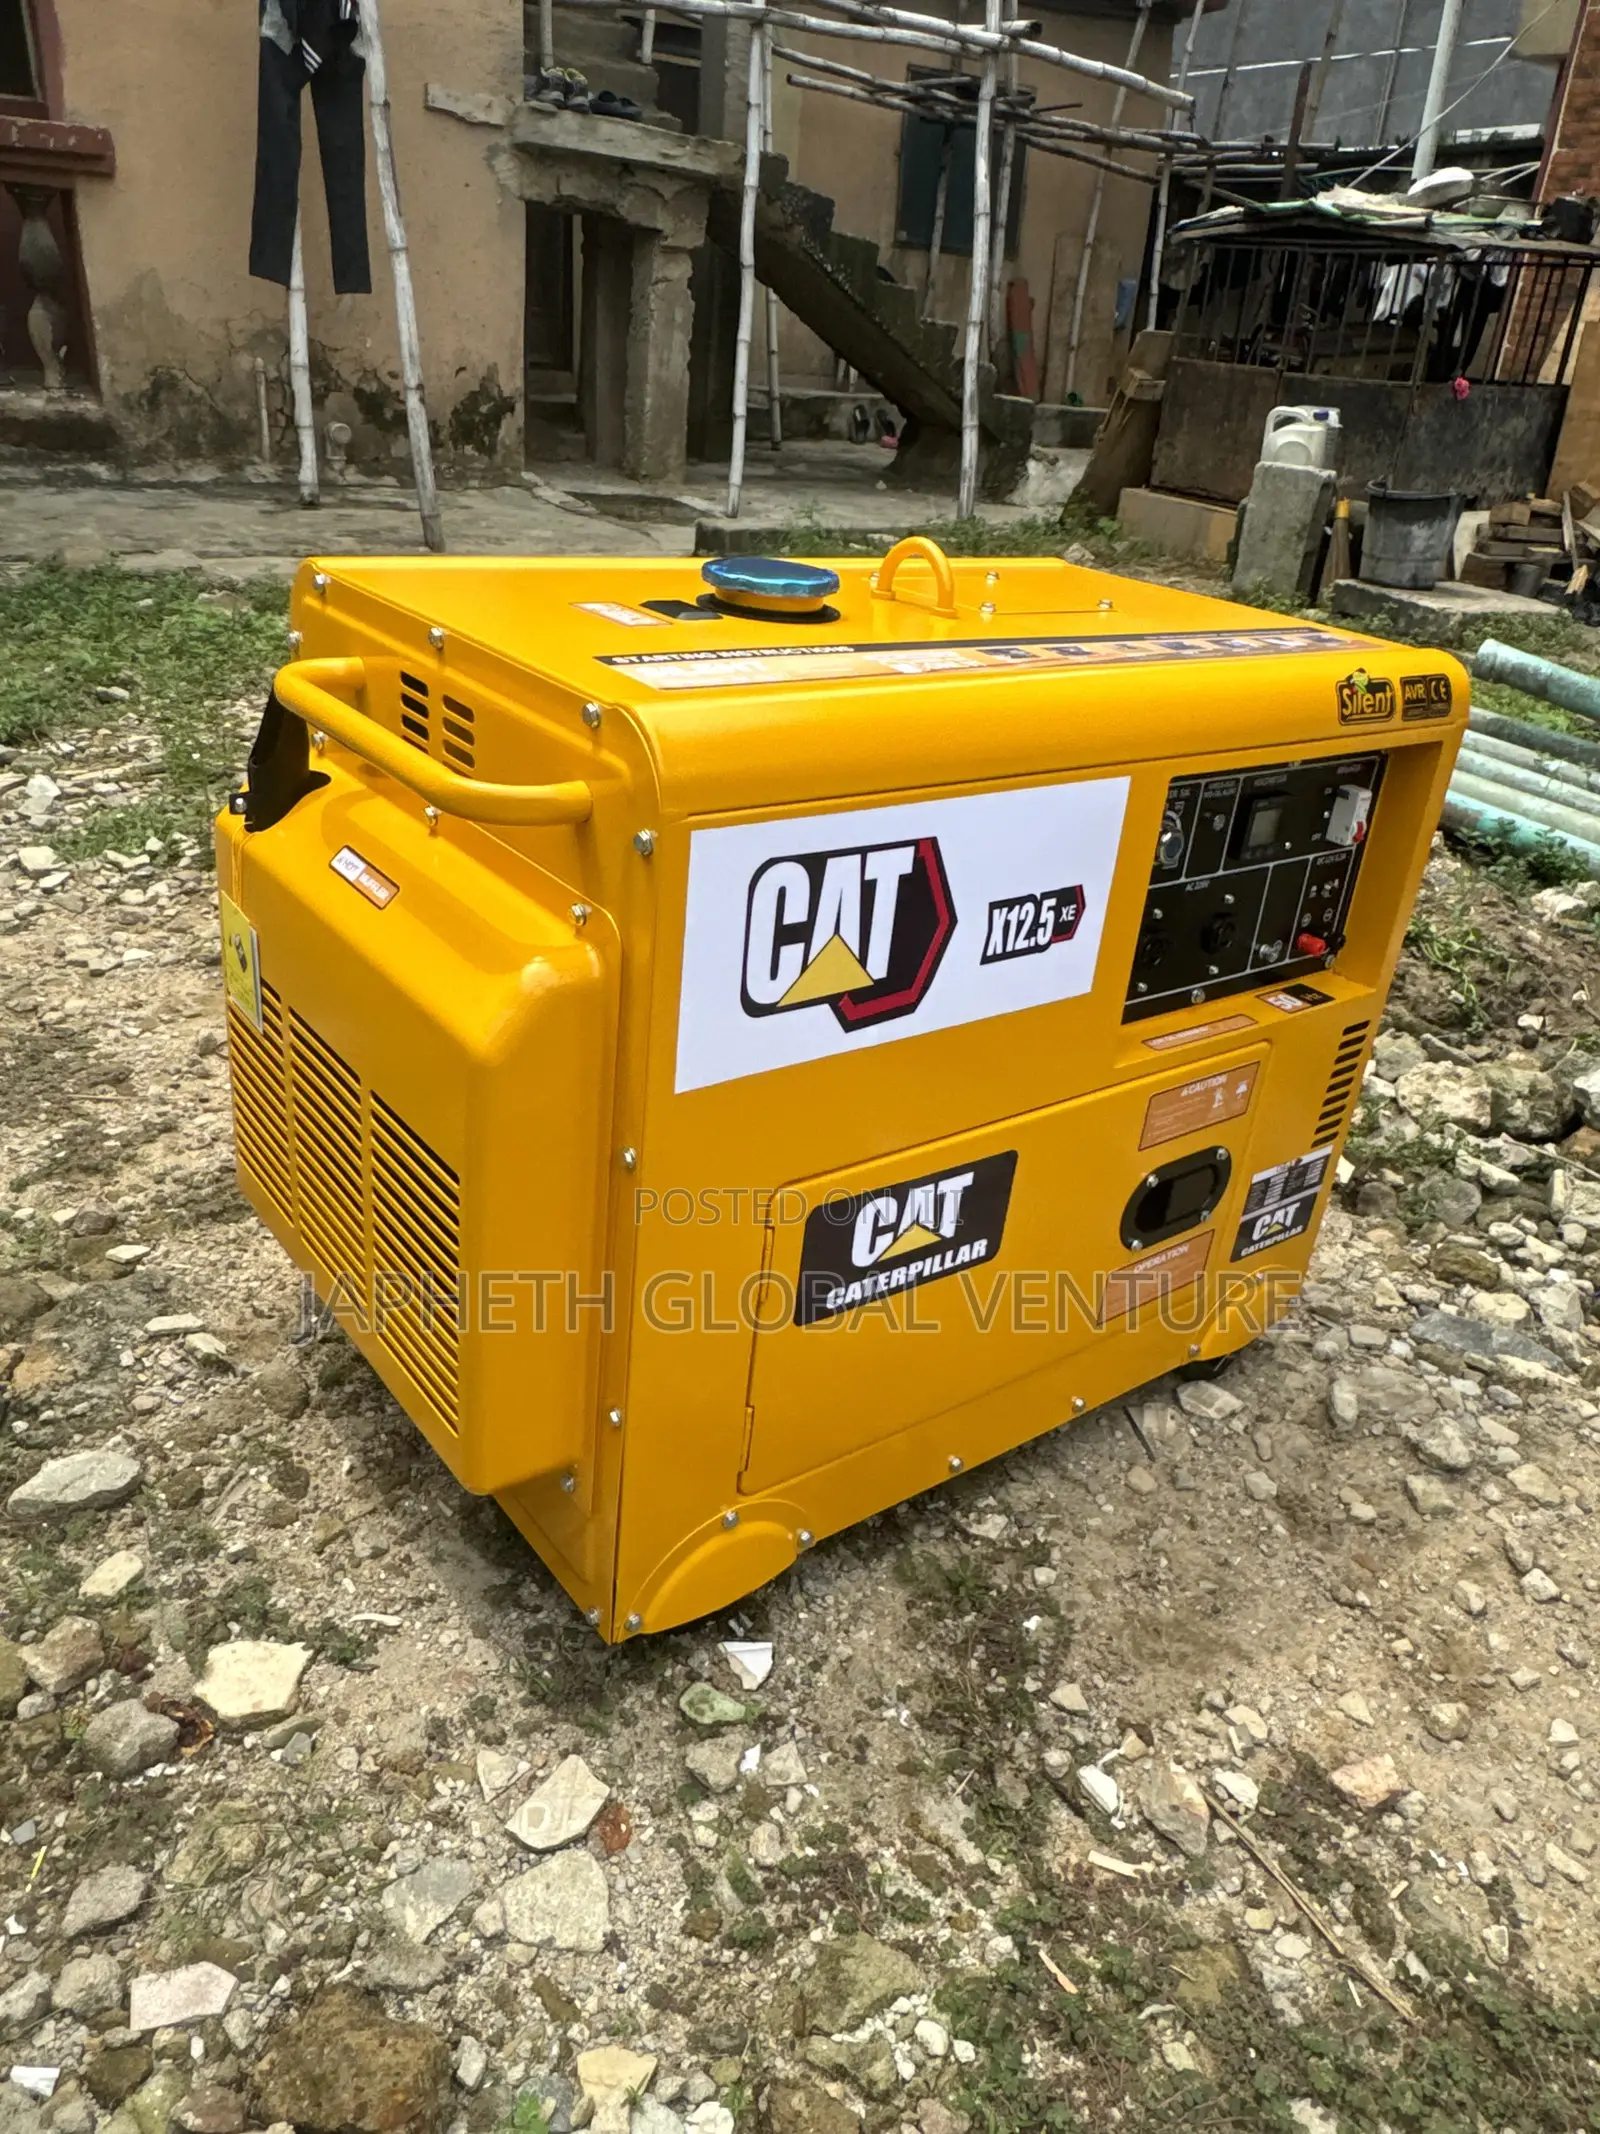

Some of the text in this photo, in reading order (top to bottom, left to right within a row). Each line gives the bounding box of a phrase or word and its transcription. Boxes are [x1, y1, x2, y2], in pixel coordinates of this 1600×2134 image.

[612, 652, 717, 664] STARTING
[1342, 684, 1394, 716] Silent
[1404, 683, 1426, 701] AVR
[745, 845, 916, 1005] CAT
[986, 897, 1077, 957] X12.5 XE
[1267, 994, 1303, 1010] 50
[1187, 1074, 1228, 1095] CAUTION
[851, 1171, 975, 1268] CAT
[1252, 1202, 1300, 1242] CAT
[1240, 1224, 1304, 1257] CATERPILLAR
[825, 1237, 989, 1310] CATERPILLAR
[1133, 1244, 1190, 1274] OPERATION
